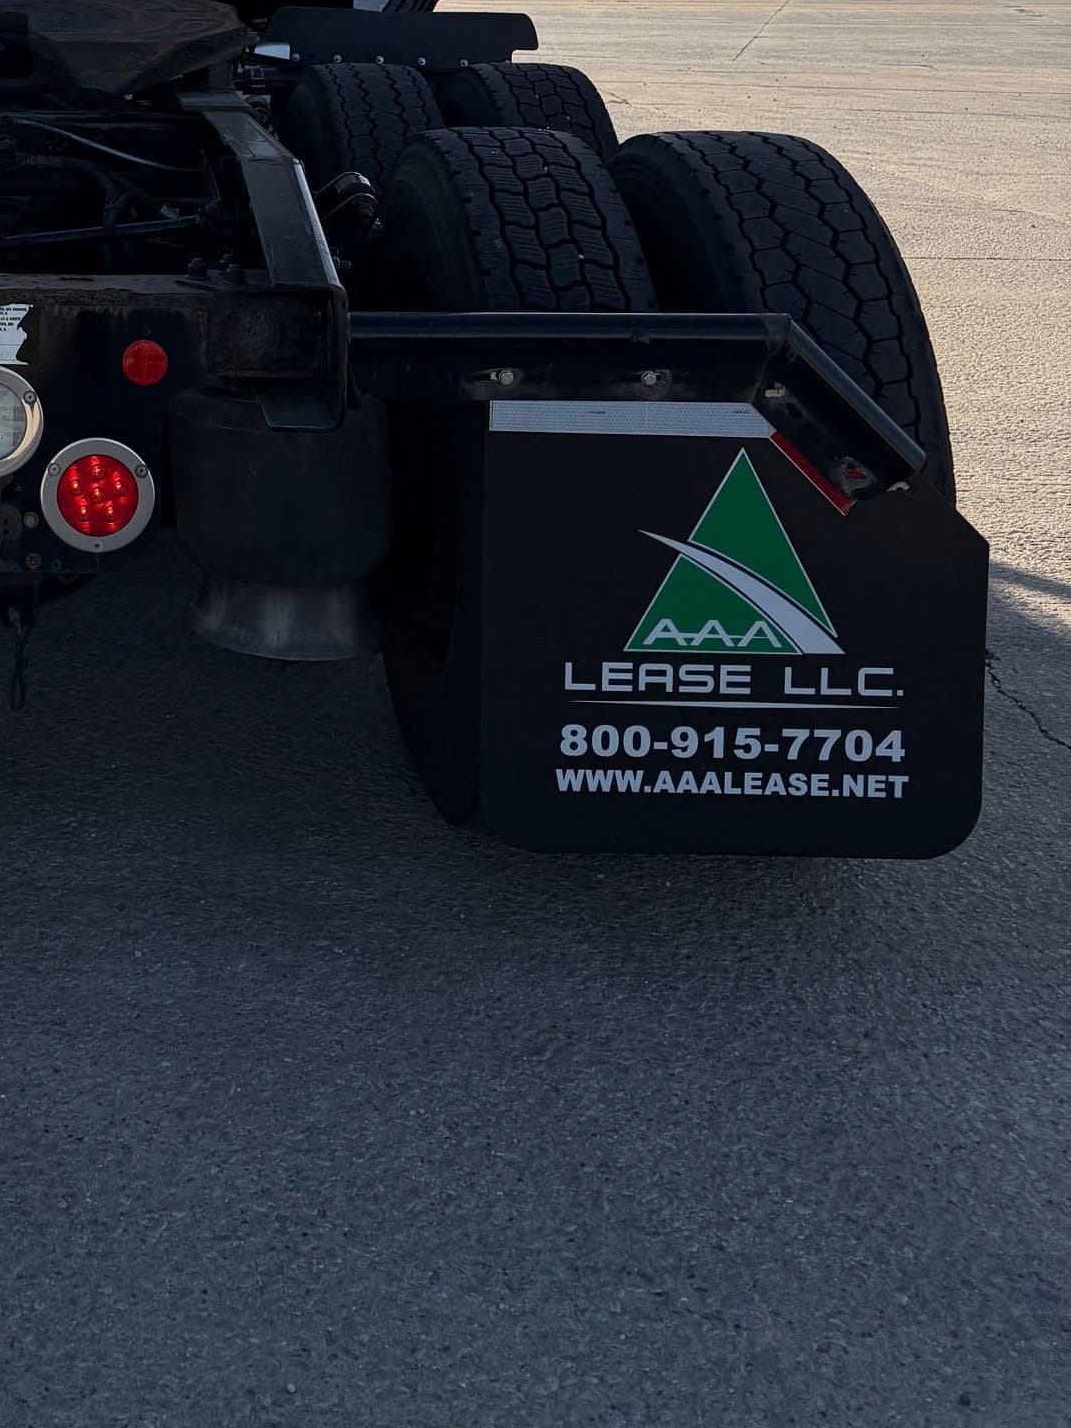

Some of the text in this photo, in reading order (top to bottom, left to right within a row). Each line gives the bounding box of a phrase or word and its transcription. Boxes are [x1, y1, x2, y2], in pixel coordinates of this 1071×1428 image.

[642, 618, 783, 649] AAA
[564, 661, 905, 697] LEASE LLC.
[559, 724, 907, 763] 800-915-7704
[556, 768, 909, 799] WWW.AAALEASE.NET
